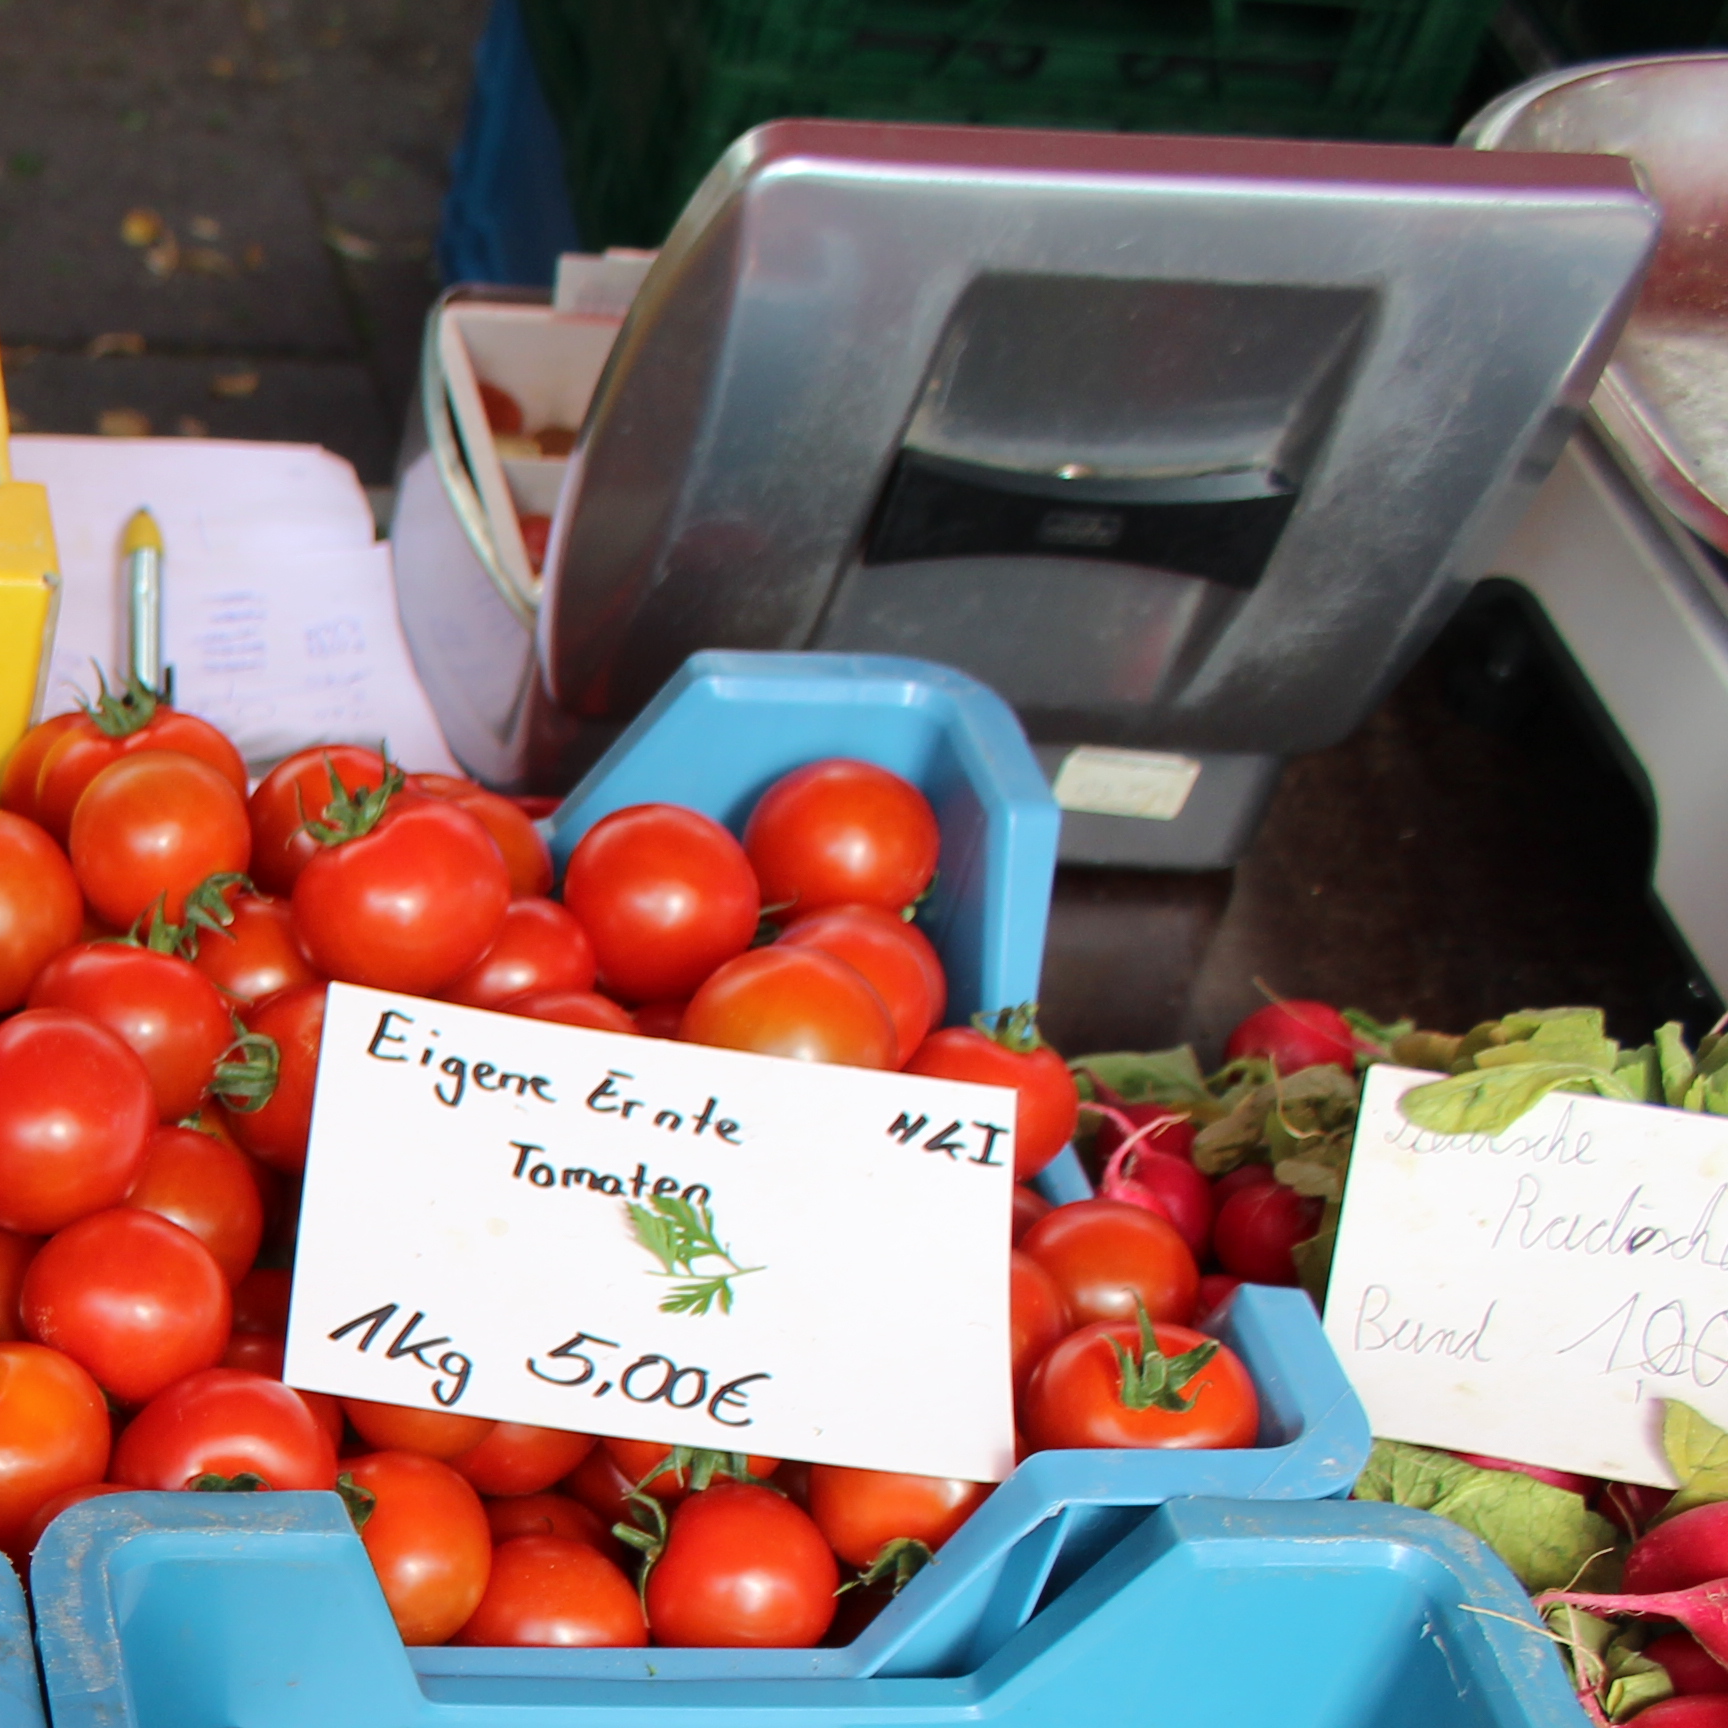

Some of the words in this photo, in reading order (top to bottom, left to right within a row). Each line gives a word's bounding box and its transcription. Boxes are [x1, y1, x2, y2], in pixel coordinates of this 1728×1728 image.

[366, 1009, 557, 1107] Eigene
[585, 1068, 744, 1146] Ernte
[508, 1141, 712, 1203] Tomaten
[1353, 1284, 1498, 1363] Bund
